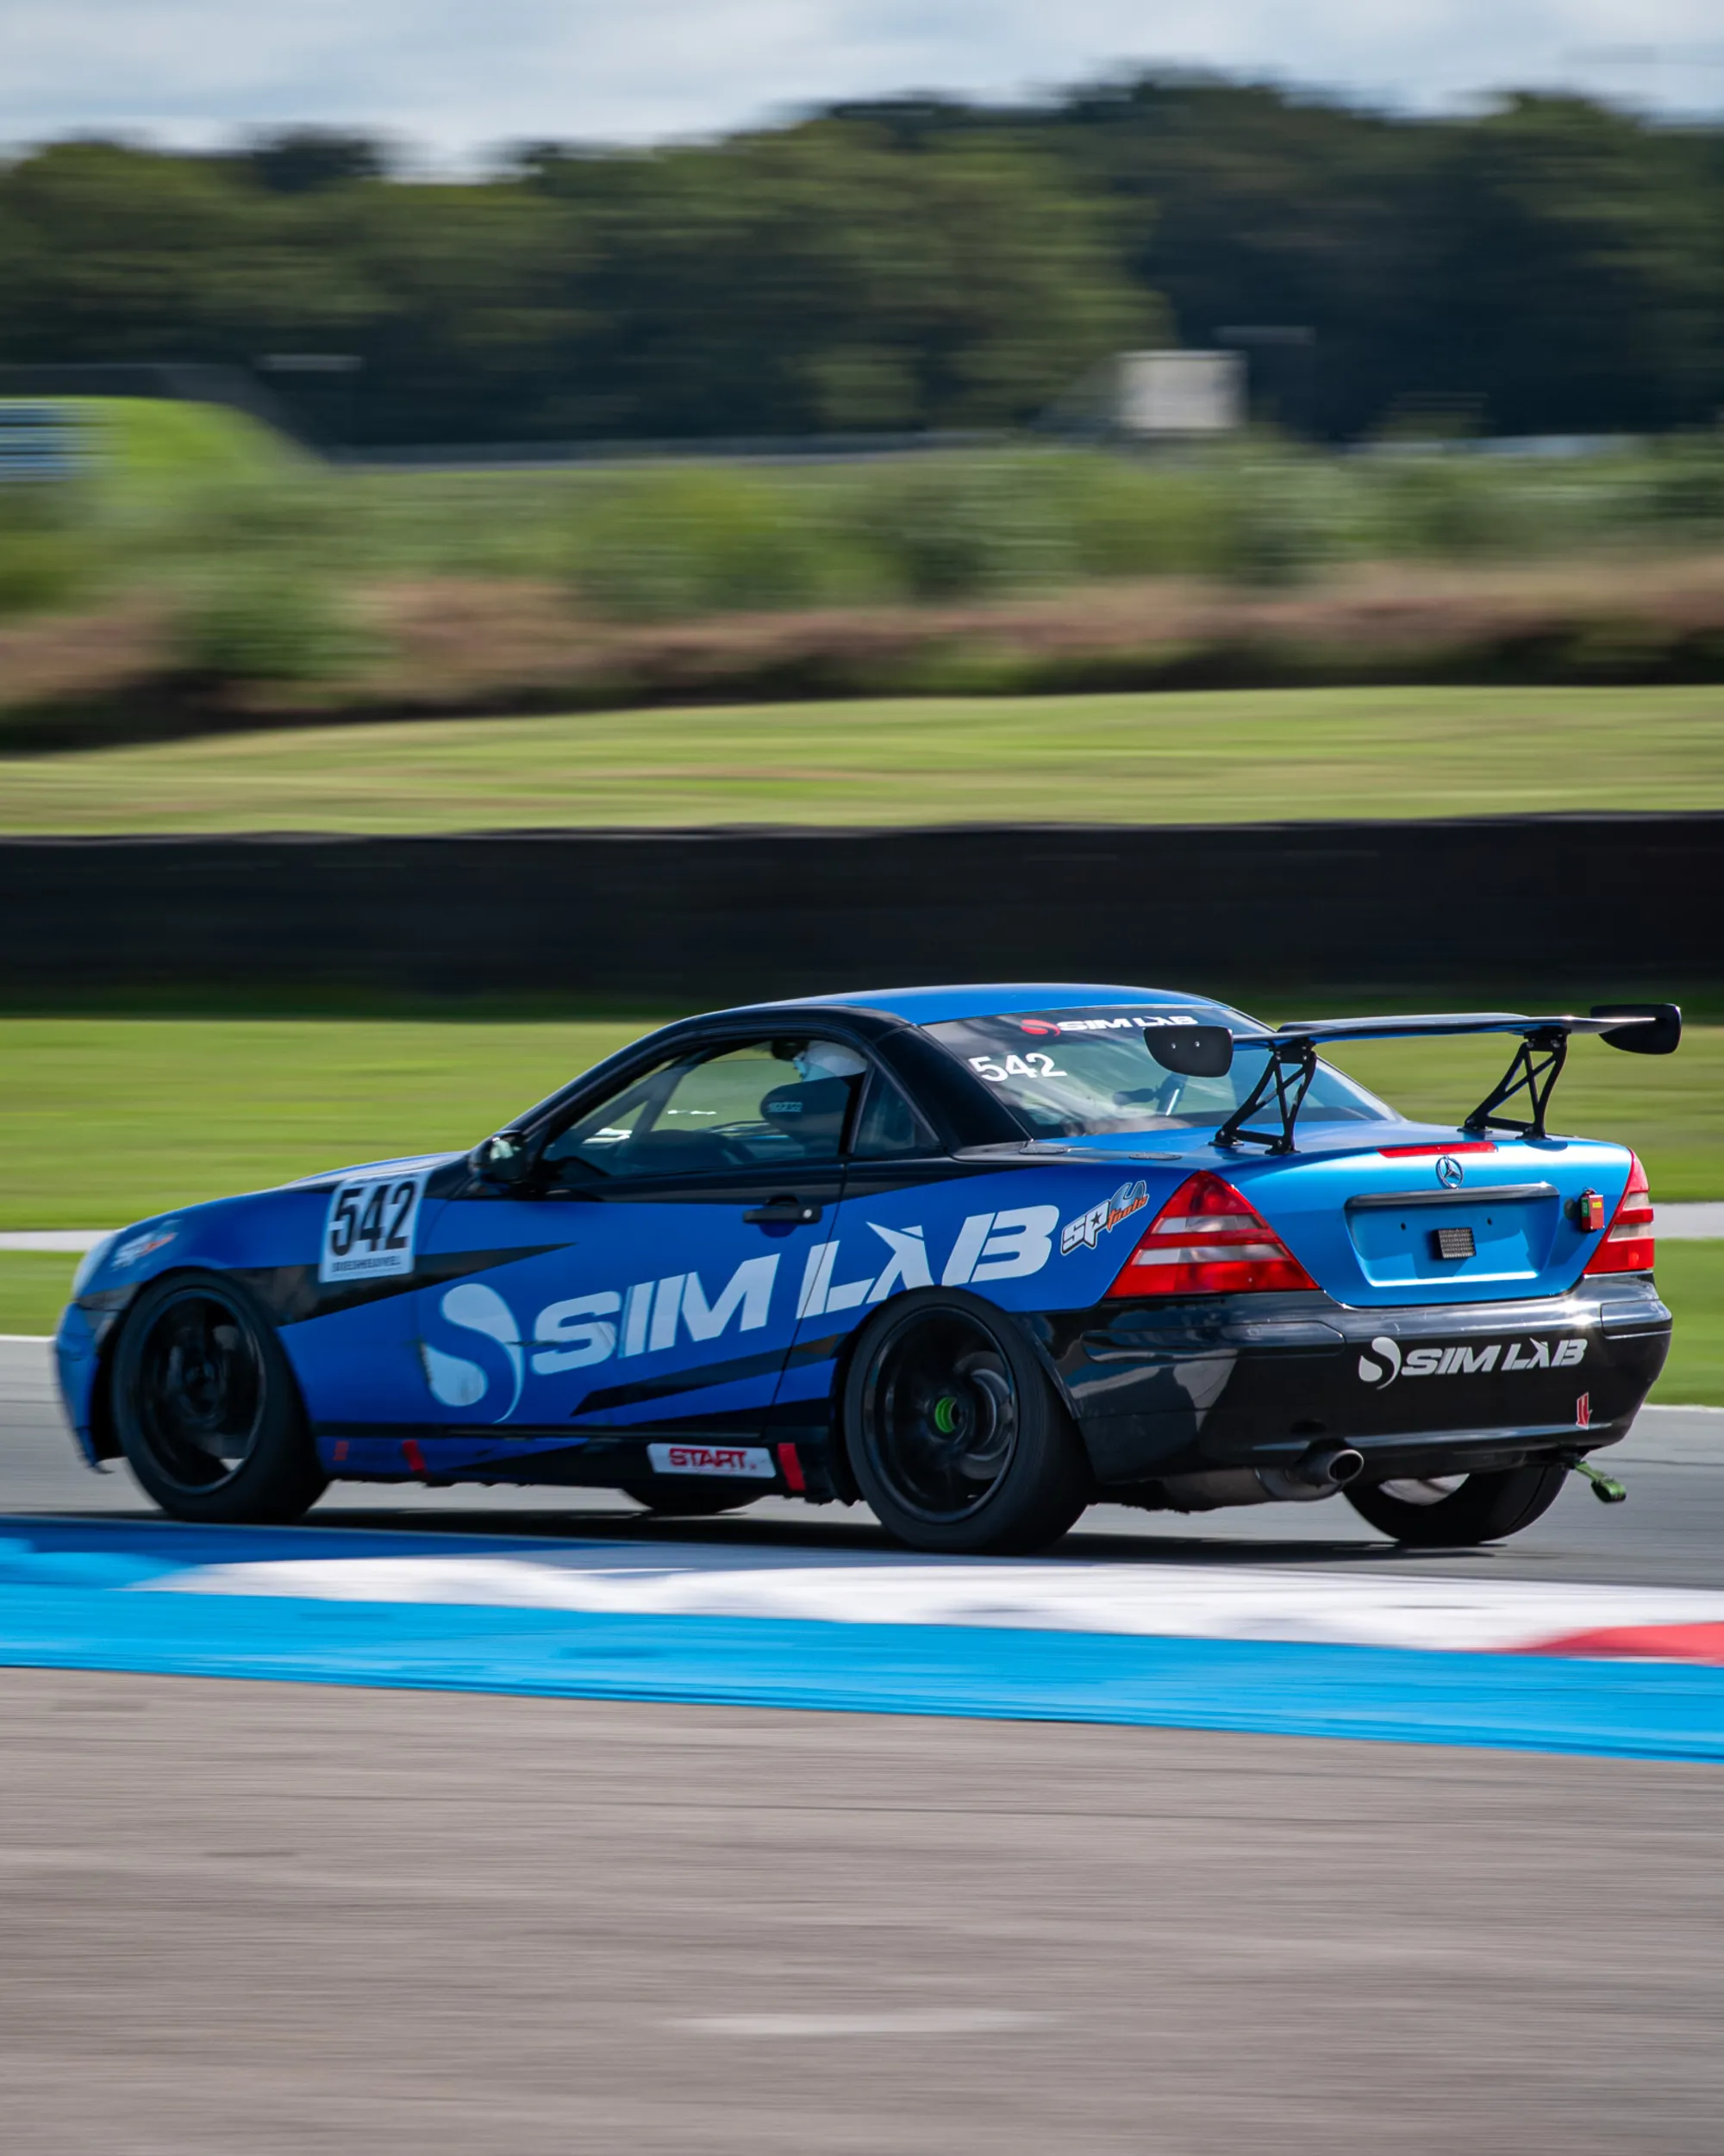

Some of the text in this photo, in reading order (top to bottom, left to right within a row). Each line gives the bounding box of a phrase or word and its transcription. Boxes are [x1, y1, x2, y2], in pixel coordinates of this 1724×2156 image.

[1058, 1016, 1199, 1032] SIM LAB
[968, 1053, 1068, 1083] 542
[331, 1181, 415, 1256] 542
[531, 1204, 1060, 1375] SIM LAB
[1401, 1337, 1588, 1376] SIM LAB
